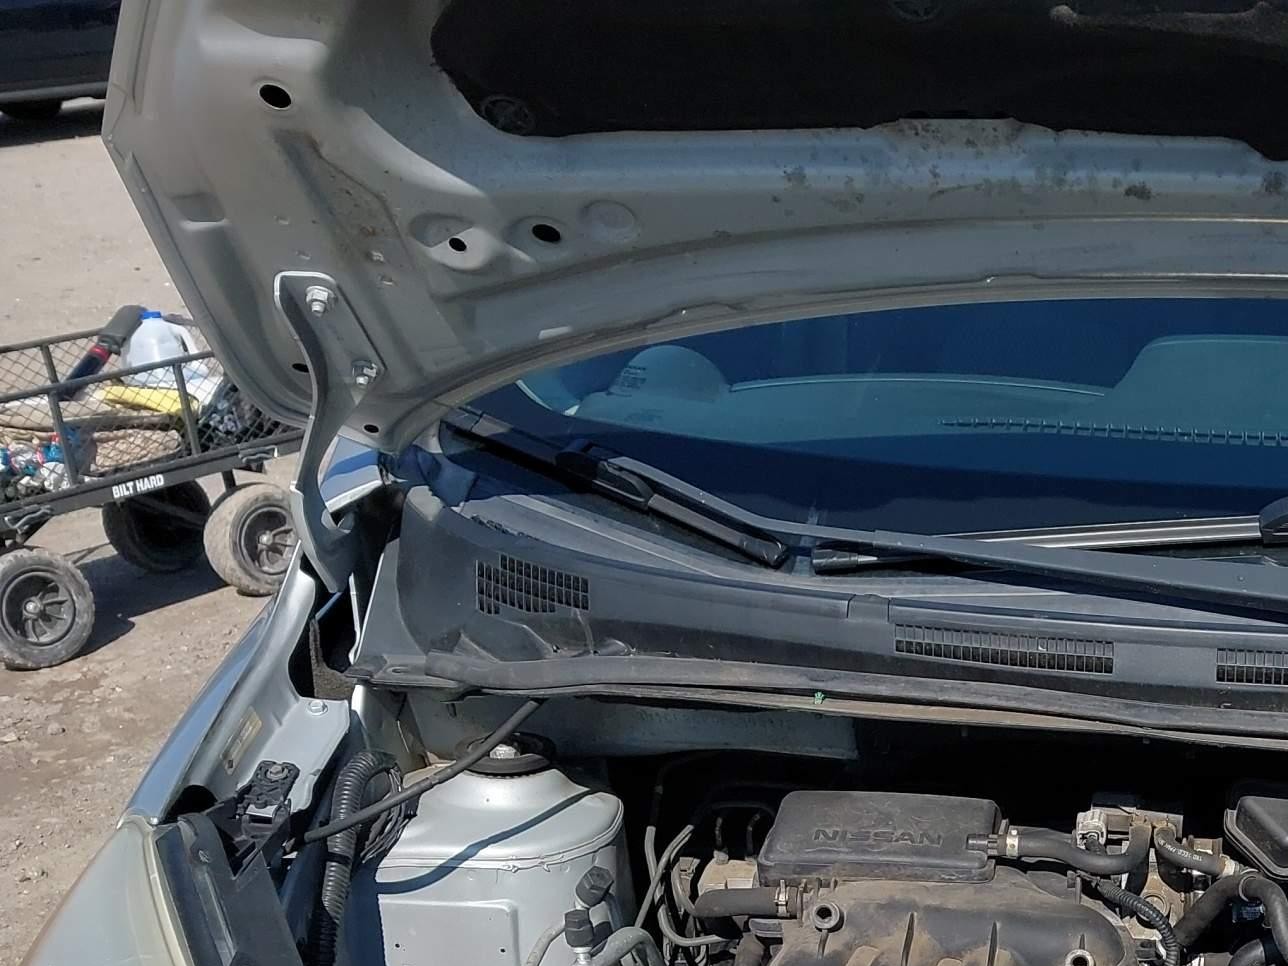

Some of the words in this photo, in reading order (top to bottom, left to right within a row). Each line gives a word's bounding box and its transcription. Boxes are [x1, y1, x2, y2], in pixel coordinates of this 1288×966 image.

[112, 481, 134, 499] BILT
[135, 474, 164, 492] HARD
[813, 829, 943, 847] NISSAN
